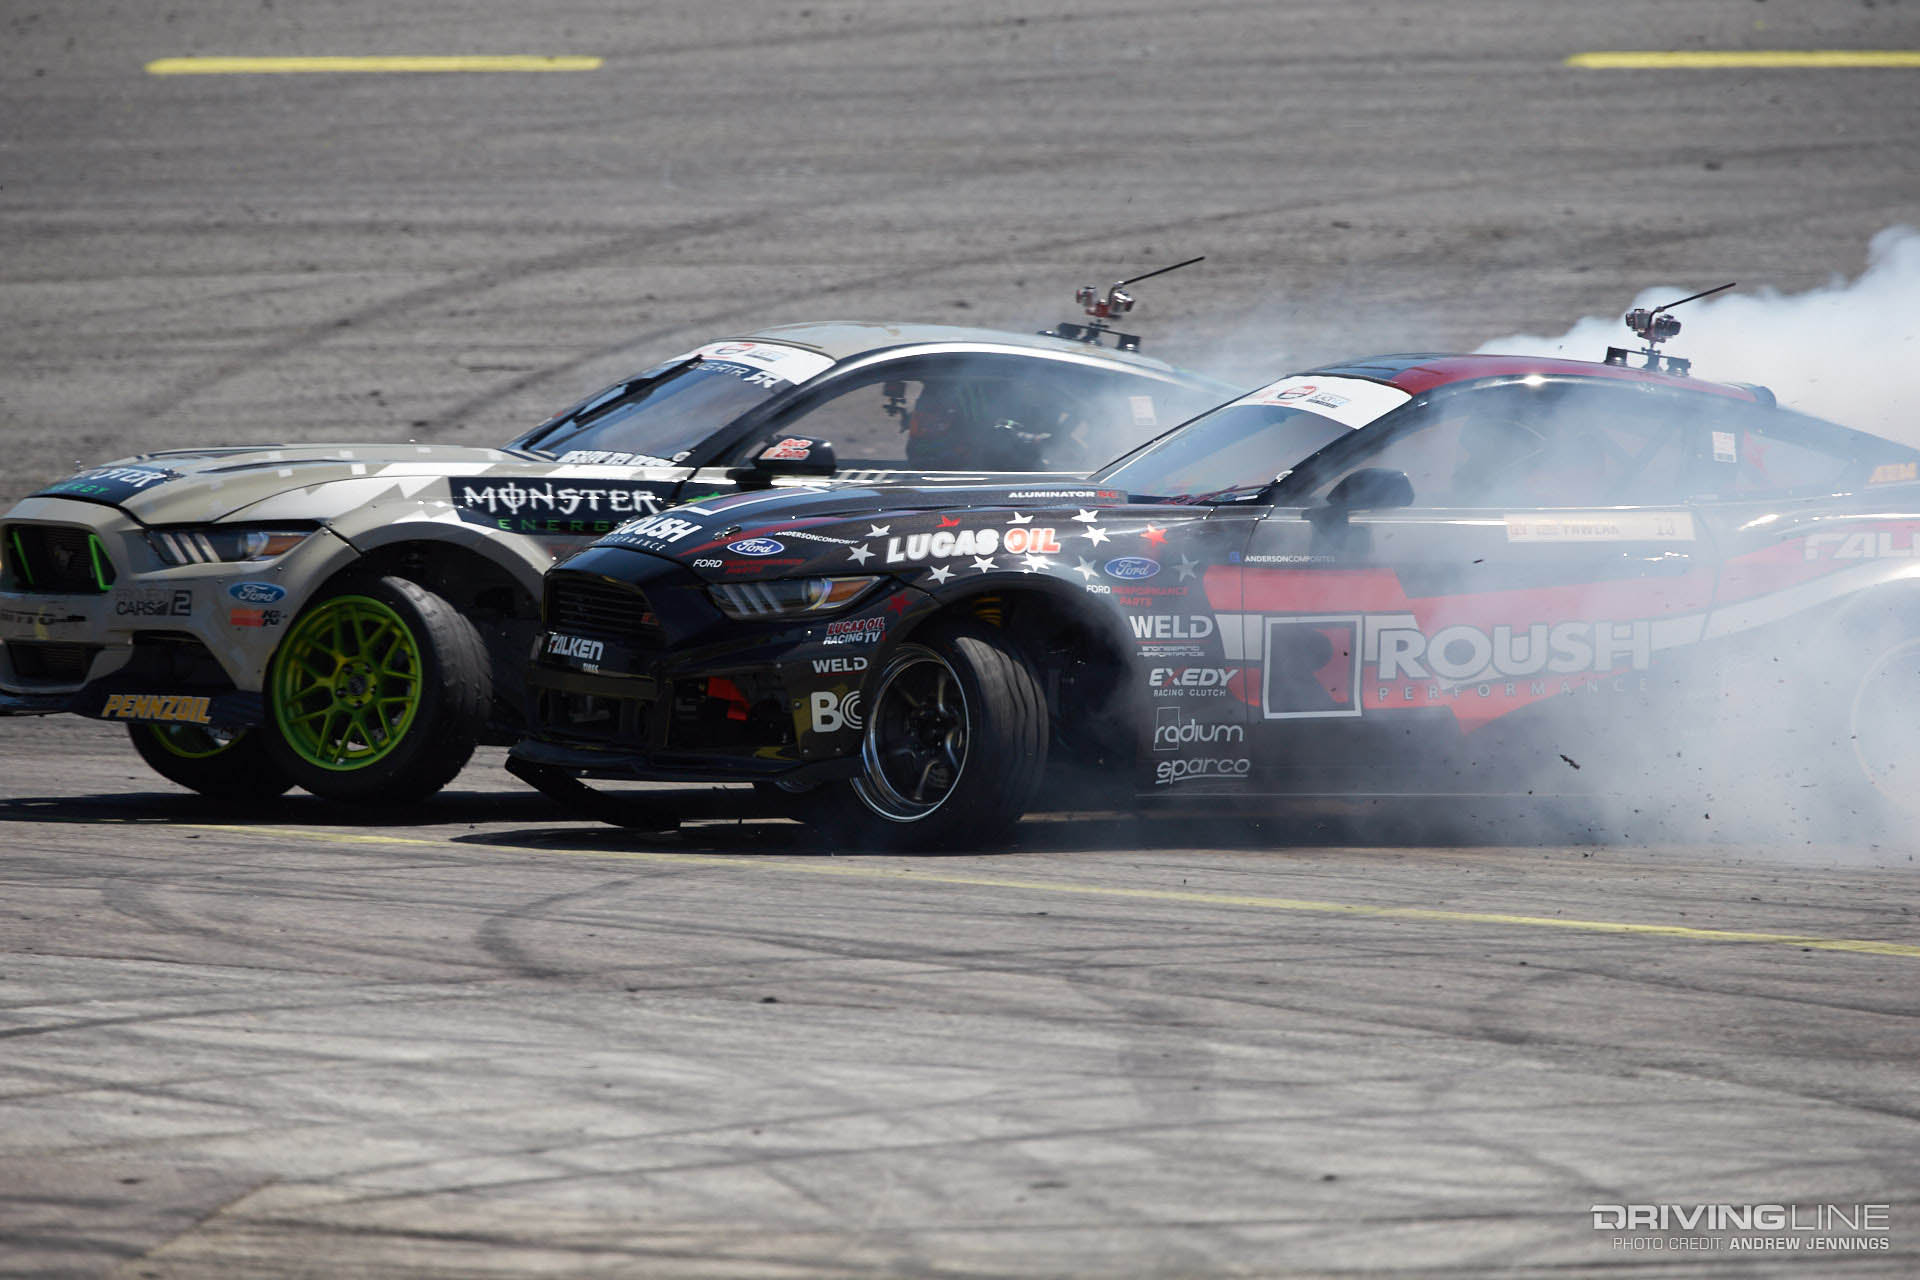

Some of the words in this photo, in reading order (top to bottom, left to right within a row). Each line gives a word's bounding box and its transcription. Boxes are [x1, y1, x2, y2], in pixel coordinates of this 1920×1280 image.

[463, 482, 660, 515] MONSTER
[1008, 490, 1096, 499] ALUMINATOR
[497, 519, 609, 532] ENERG
[616, 516, 703, 543] OUSH
[737, 539, 776, 554] Ford
[886, 529, 999, 564] LUCAS
[1004, 528, 1061, 554] OIL
[1803, 531, 1920, 561] FAL
[692, 559, 723, 568] FORD
[1114, 560, 1150, 577] Ford
[237, 584, 278, 602] Ford
[1086, 585, 1111, 594] FORD
[826, 619, 866, 636] LUCAS
[866, 617, 884, 632] OIL
[1129, 615, 1213, 638] WELD
[823, 632, 864, 646] RACING
[865, 630, 881, 643] TV
[547, 635, 604, 661] FALKEN
[1378, 620, 1651, 681] ROUSH
[811, 657, 868, 673] WELD
[1149, 668, 1239, 687] EXEDY
[1153, 689, 1184, 697] RACING
[1189, 689, 1226, 697] CLUTCH
[1378, 679, 1649, 701] PERFORMANCE
[102, 695, 213, 724] PENNZOIL
[1154, 719, 1243, 743] radium
[1157, 758, 1250, 784] sparco
